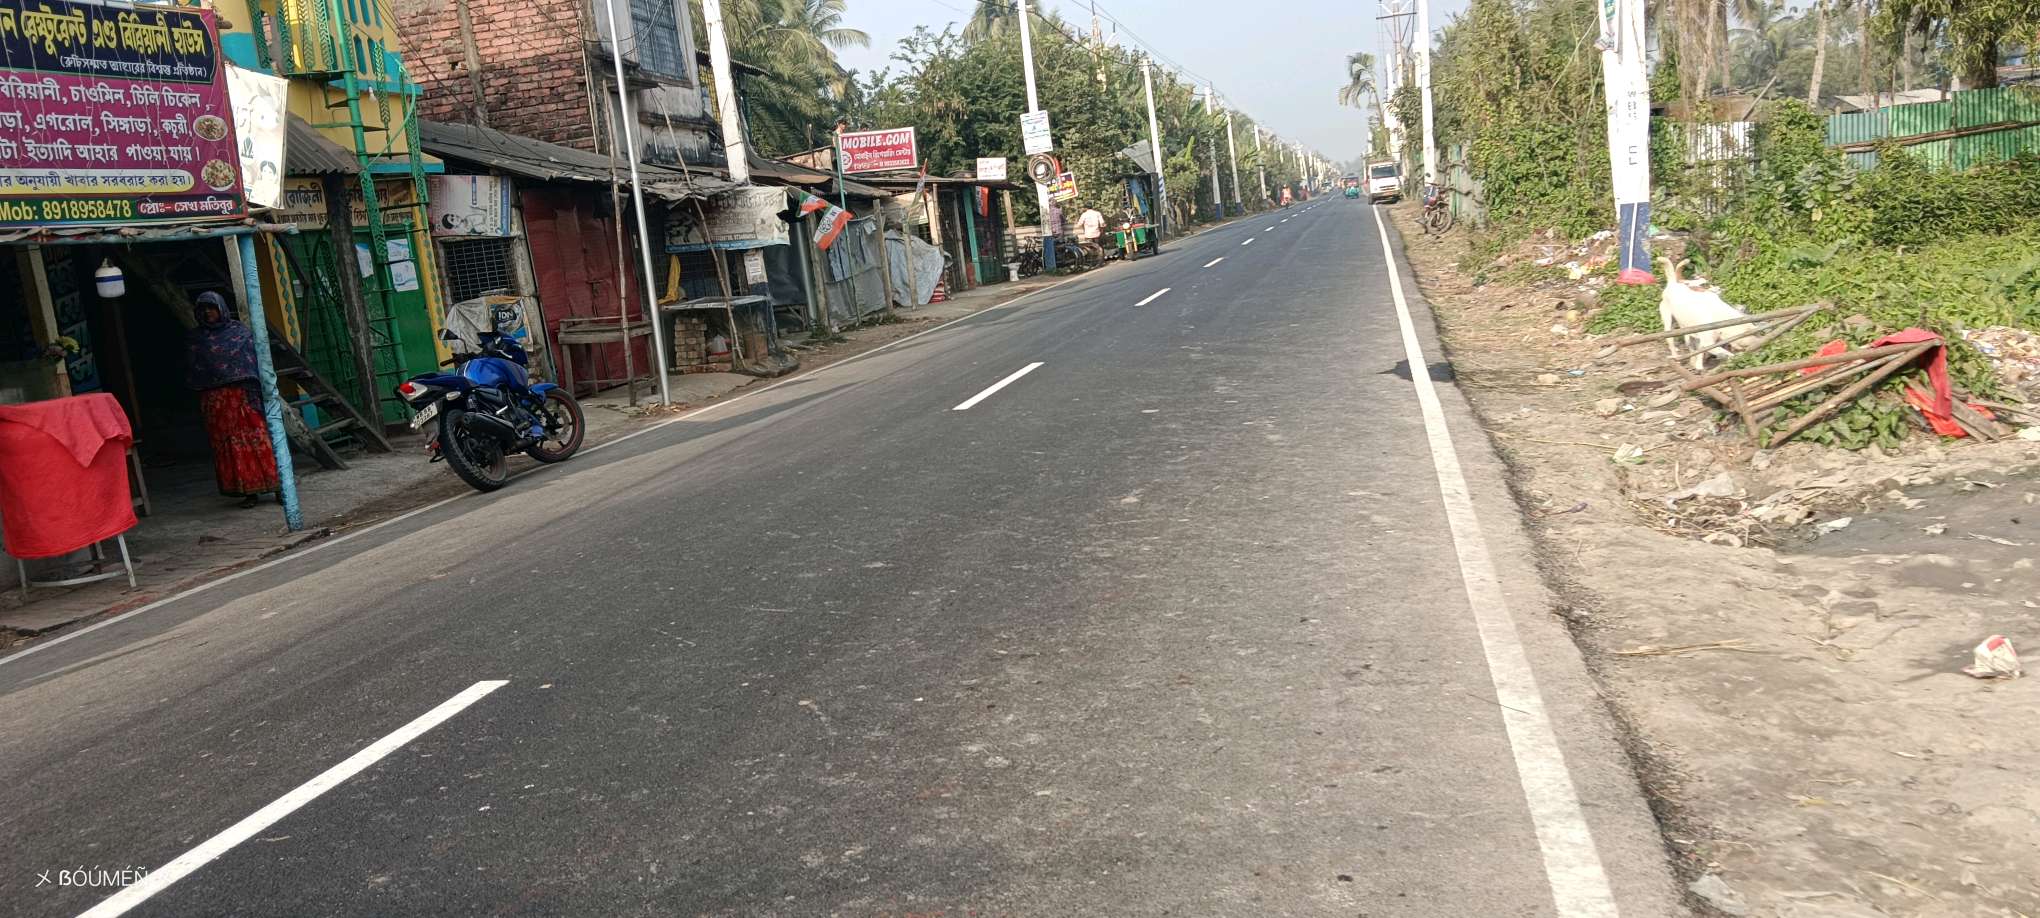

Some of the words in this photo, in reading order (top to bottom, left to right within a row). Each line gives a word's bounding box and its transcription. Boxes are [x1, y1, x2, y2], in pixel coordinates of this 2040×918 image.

[117, 11, 172, 55] বিরিয়ানী
[171, 19, 206, 57] হাউস
[109, 60, 146, 75] আহারের
[22, 136, 73, 162] ইত্যাদি
[74, 143, 118, 164] আহার
[126, 143, 168, 166] পাওয়া
[842, 132, 910, 150] MOBILE.COM
[15, 170, 62, 191] অনুযায়ী
[64, 174, 98, 187] খাবার
[101, 174, 145, 188] সরবরাহ
[146, 175, 169, 187] করা
[0, 200, 39, 221] Mob:
[42, 200, 132, 219] 8918958478
[174, 201, 198, 212] সেখ
[198, 195, 233, 214] মতিবুর
